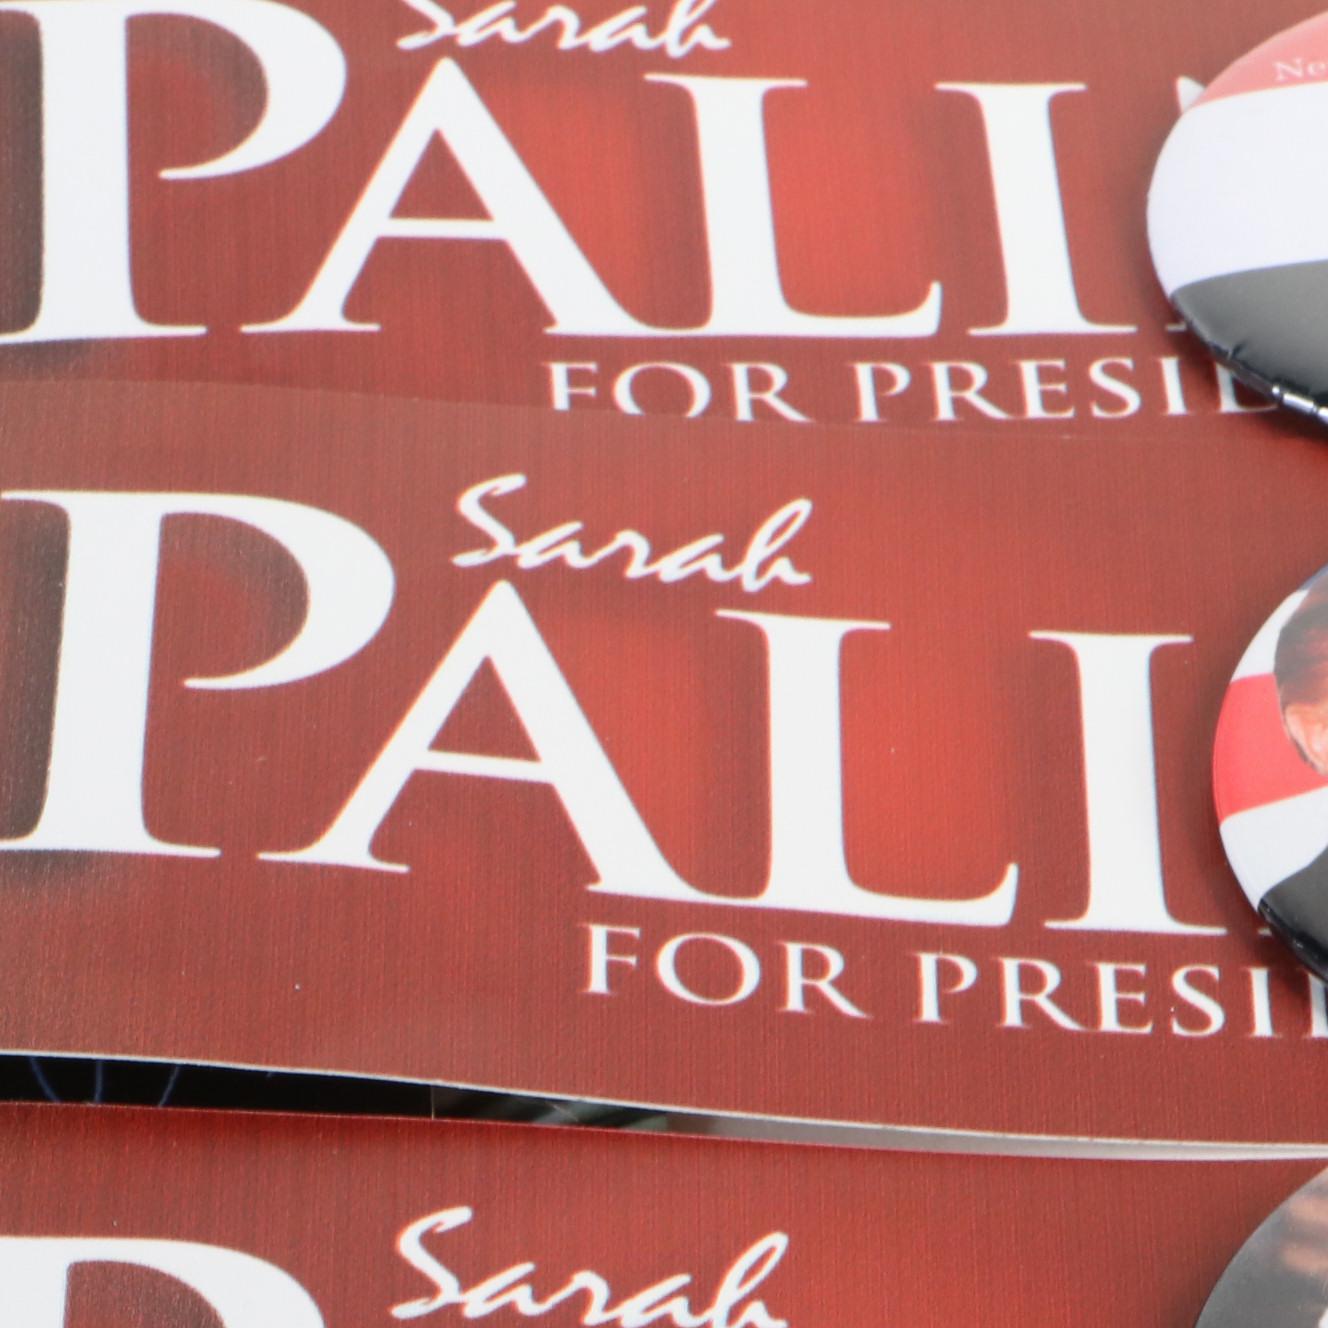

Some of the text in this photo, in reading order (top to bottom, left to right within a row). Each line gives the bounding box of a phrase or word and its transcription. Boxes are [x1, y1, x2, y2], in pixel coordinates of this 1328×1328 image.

[0, 0, 1206, 343] PALI
[548, 362, 812, 423] FOR
[452, 473, 811, 591] Sarah
[0, 489, 1272, 936] PALI
[580, 924, 873, 1020] FOR
